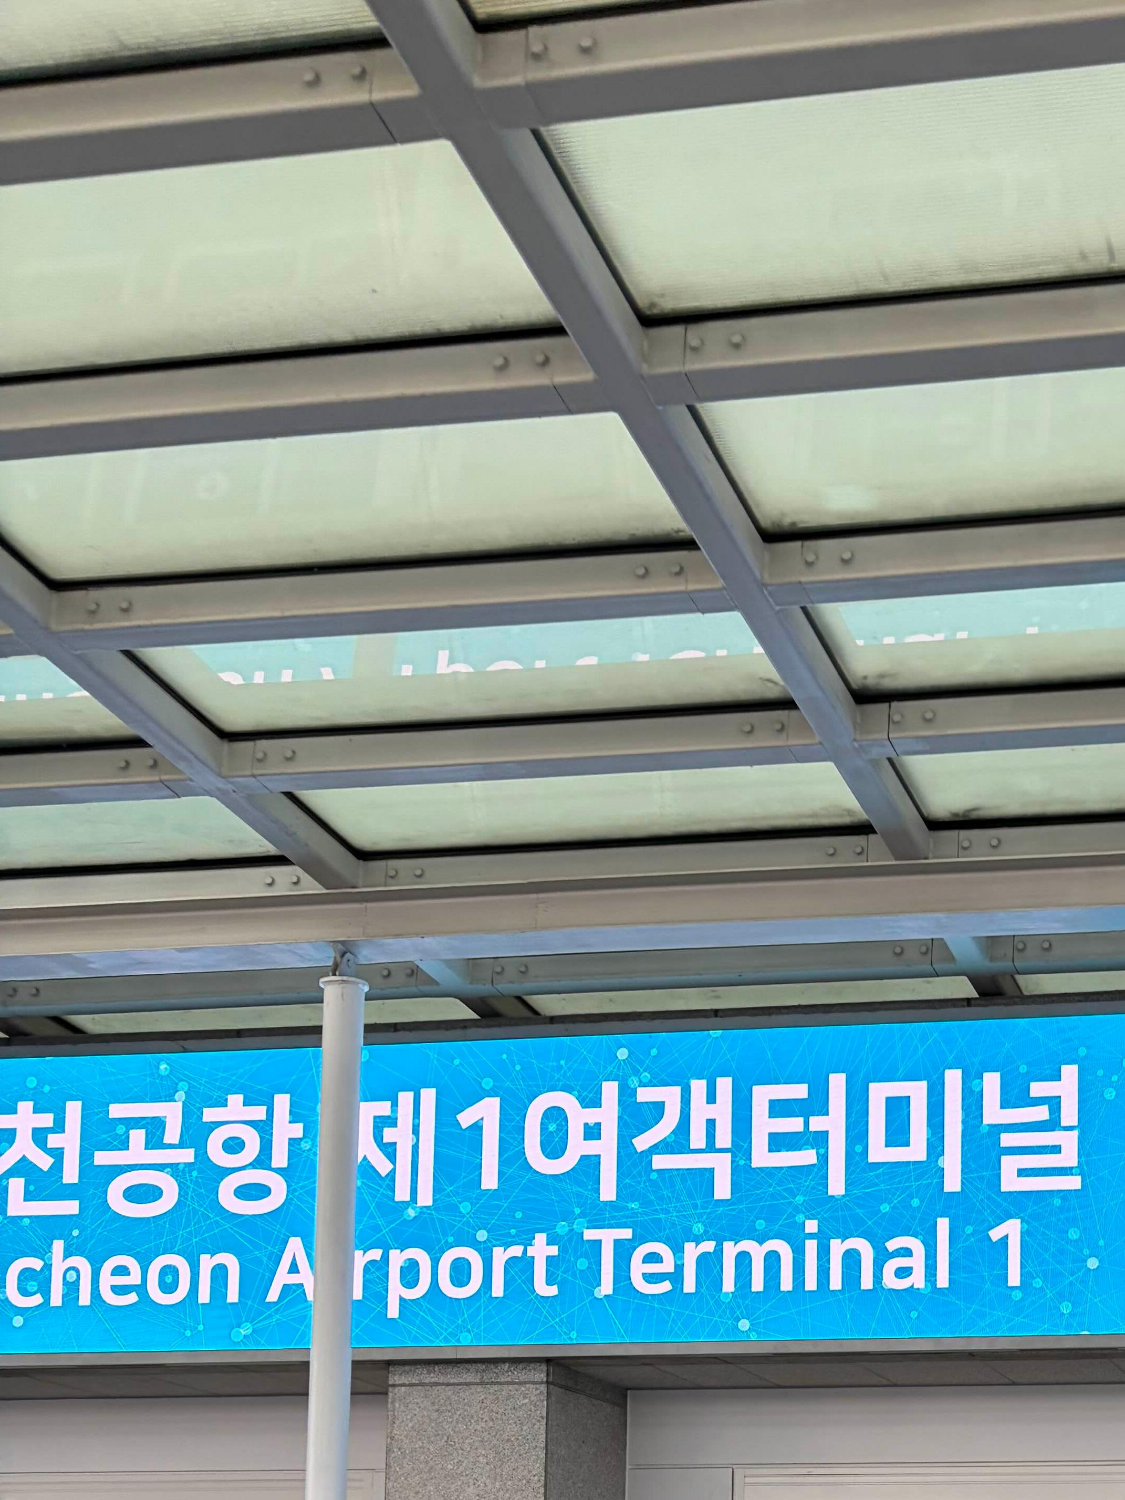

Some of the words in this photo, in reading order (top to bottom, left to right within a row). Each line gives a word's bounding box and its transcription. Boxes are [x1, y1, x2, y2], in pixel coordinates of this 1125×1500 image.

[0, 1094, 304, 1218] 천공항
[356, 1065, 1082, 1207] 제1여객터미널
[5, 1240, 240, 1309] cheon
[265, 1234, 559, 1320] Arport
[582, 1217, 950, 1297] Terminal
[987, 1218, 1022, 1287] 1
